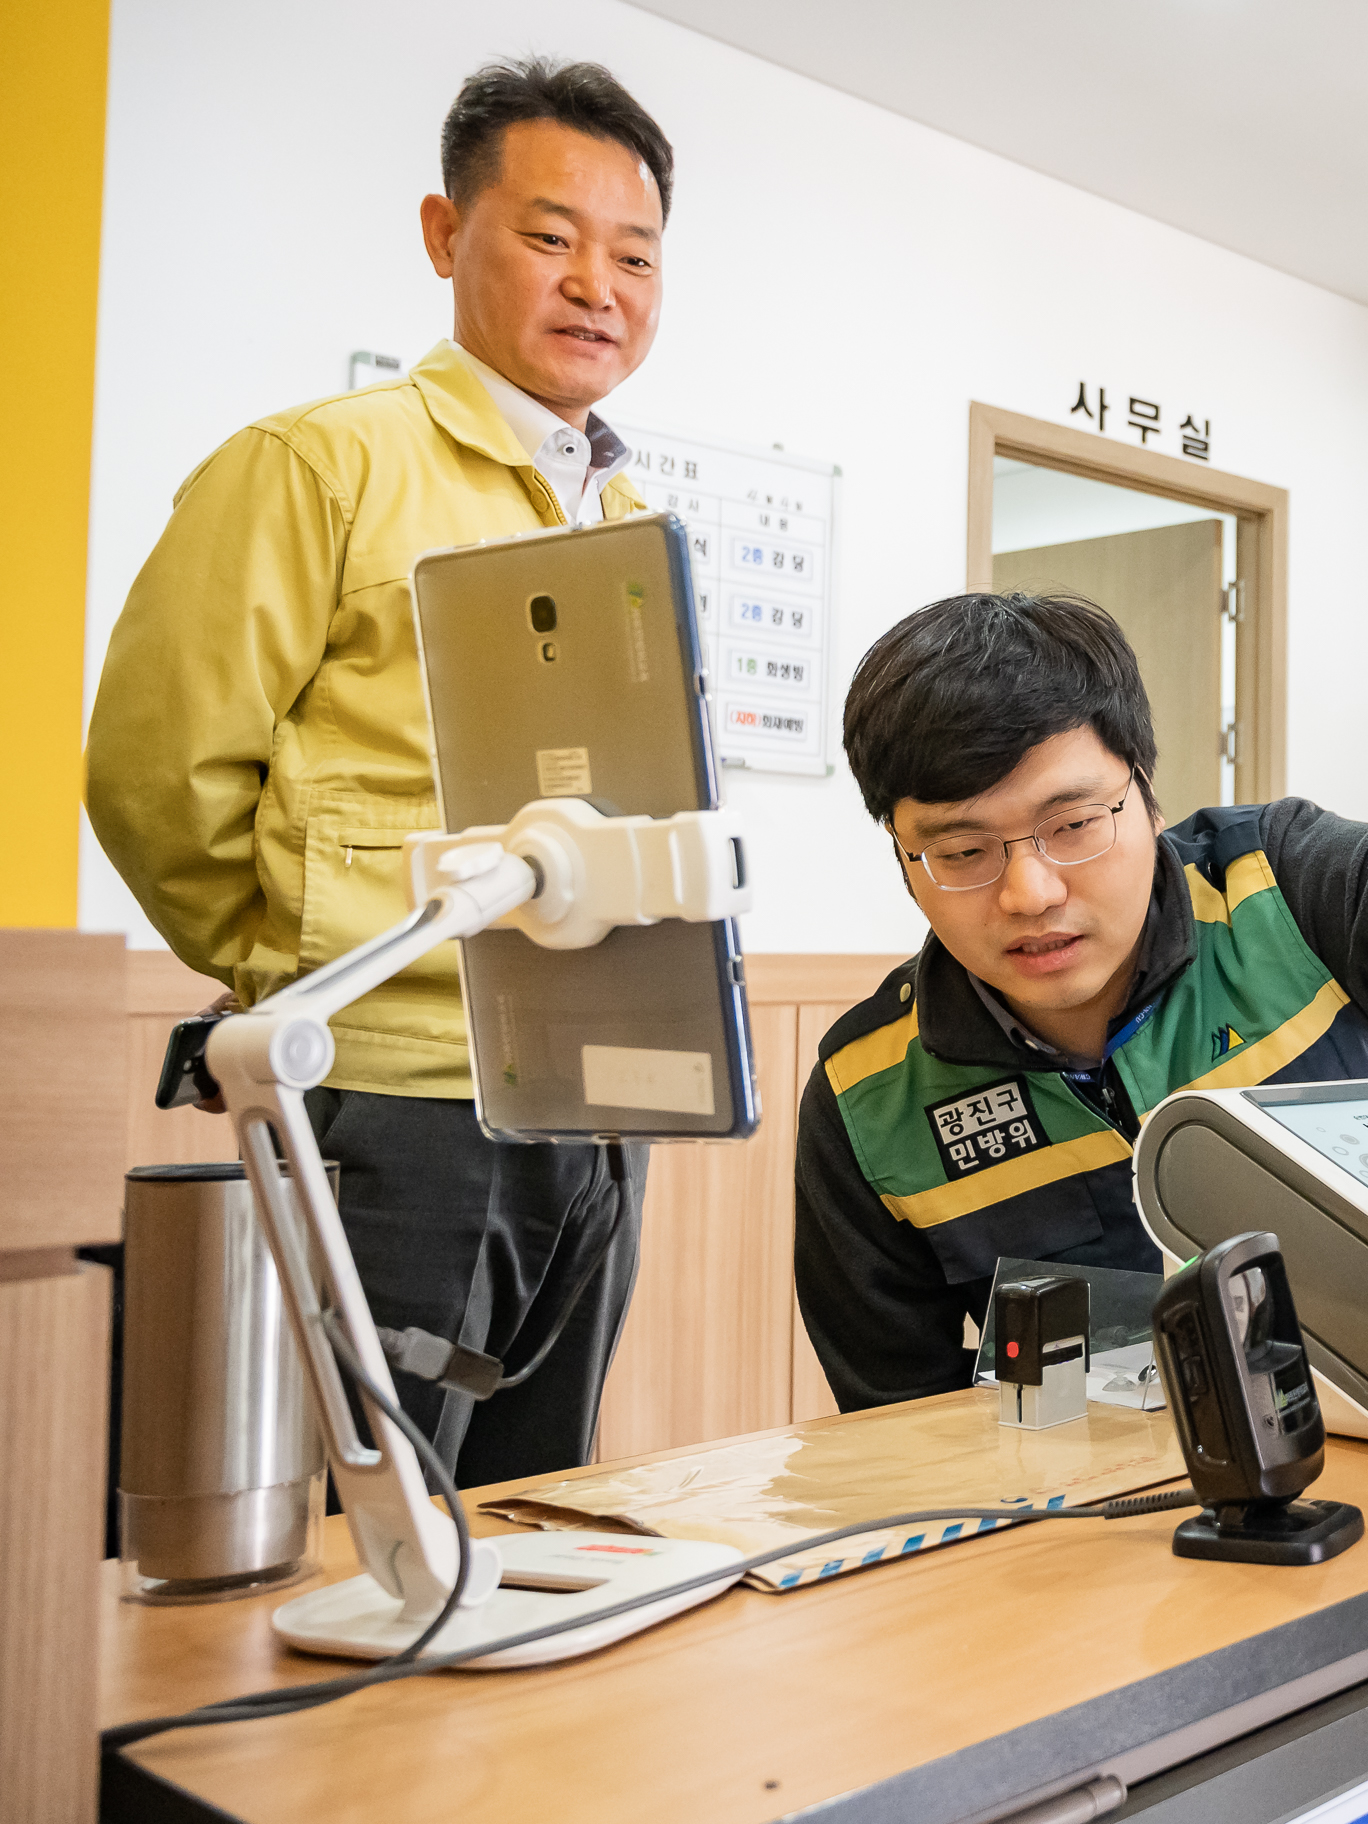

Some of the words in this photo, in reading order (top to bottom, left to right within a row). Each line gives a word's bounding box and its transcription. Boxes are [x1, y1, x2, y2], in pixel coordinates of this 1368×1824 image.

[1070, 381, 1210, 461] 사무실
[939, 1088, 1019, 1136] 광진구
[949, 1119, 1037, 1170] 민방위
